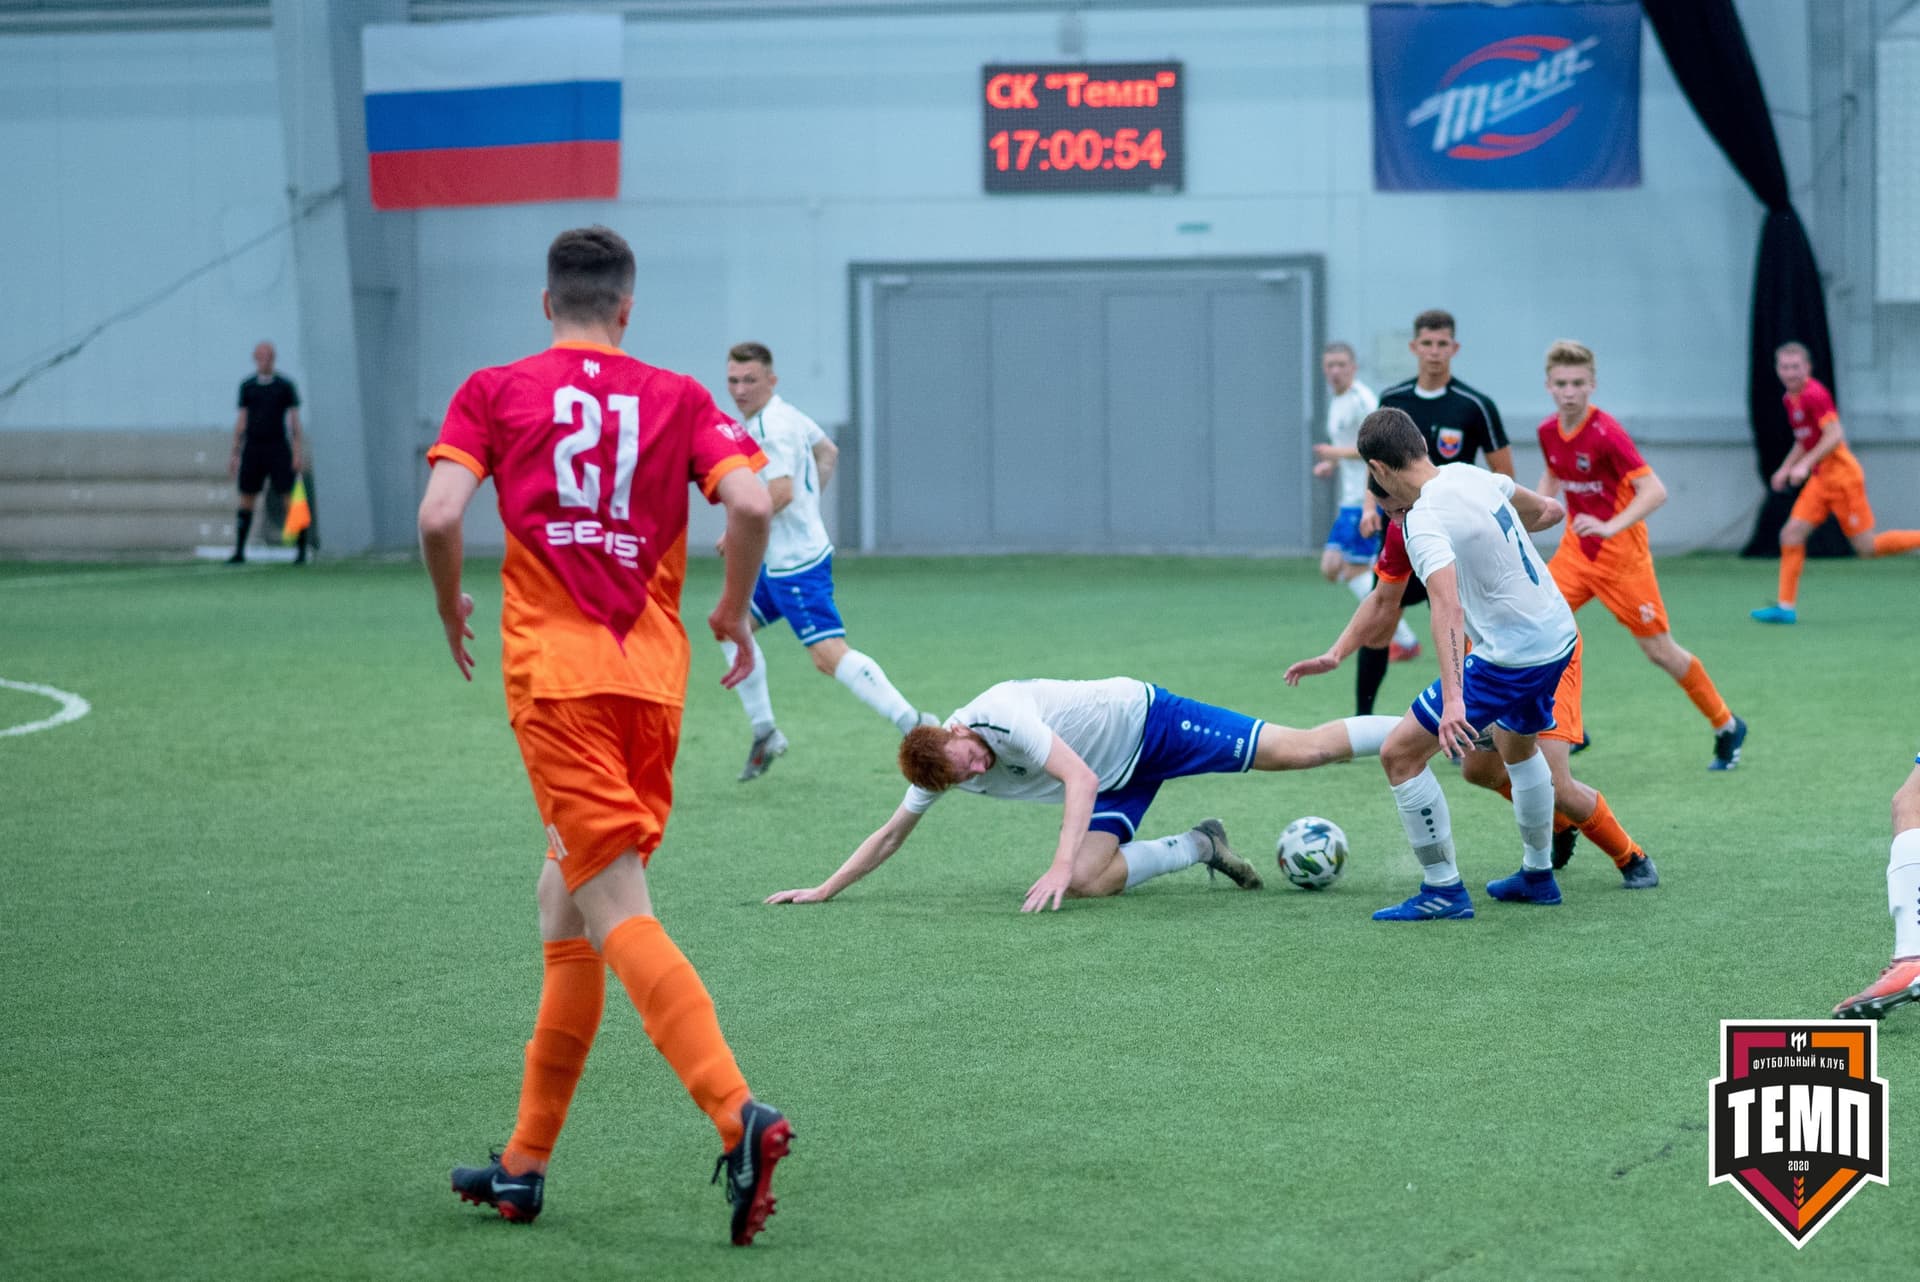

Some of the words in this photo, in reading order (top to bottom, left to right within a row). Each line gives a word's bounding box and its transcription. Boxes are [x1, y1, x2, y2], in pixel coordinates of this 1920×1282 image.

[986, 73, 1039, 109] СК
[1045, 71, 1176, 108] "Темп"
[988, 128, 1167, 171] 17:00:54
[552, 385, 640, 521] 21
